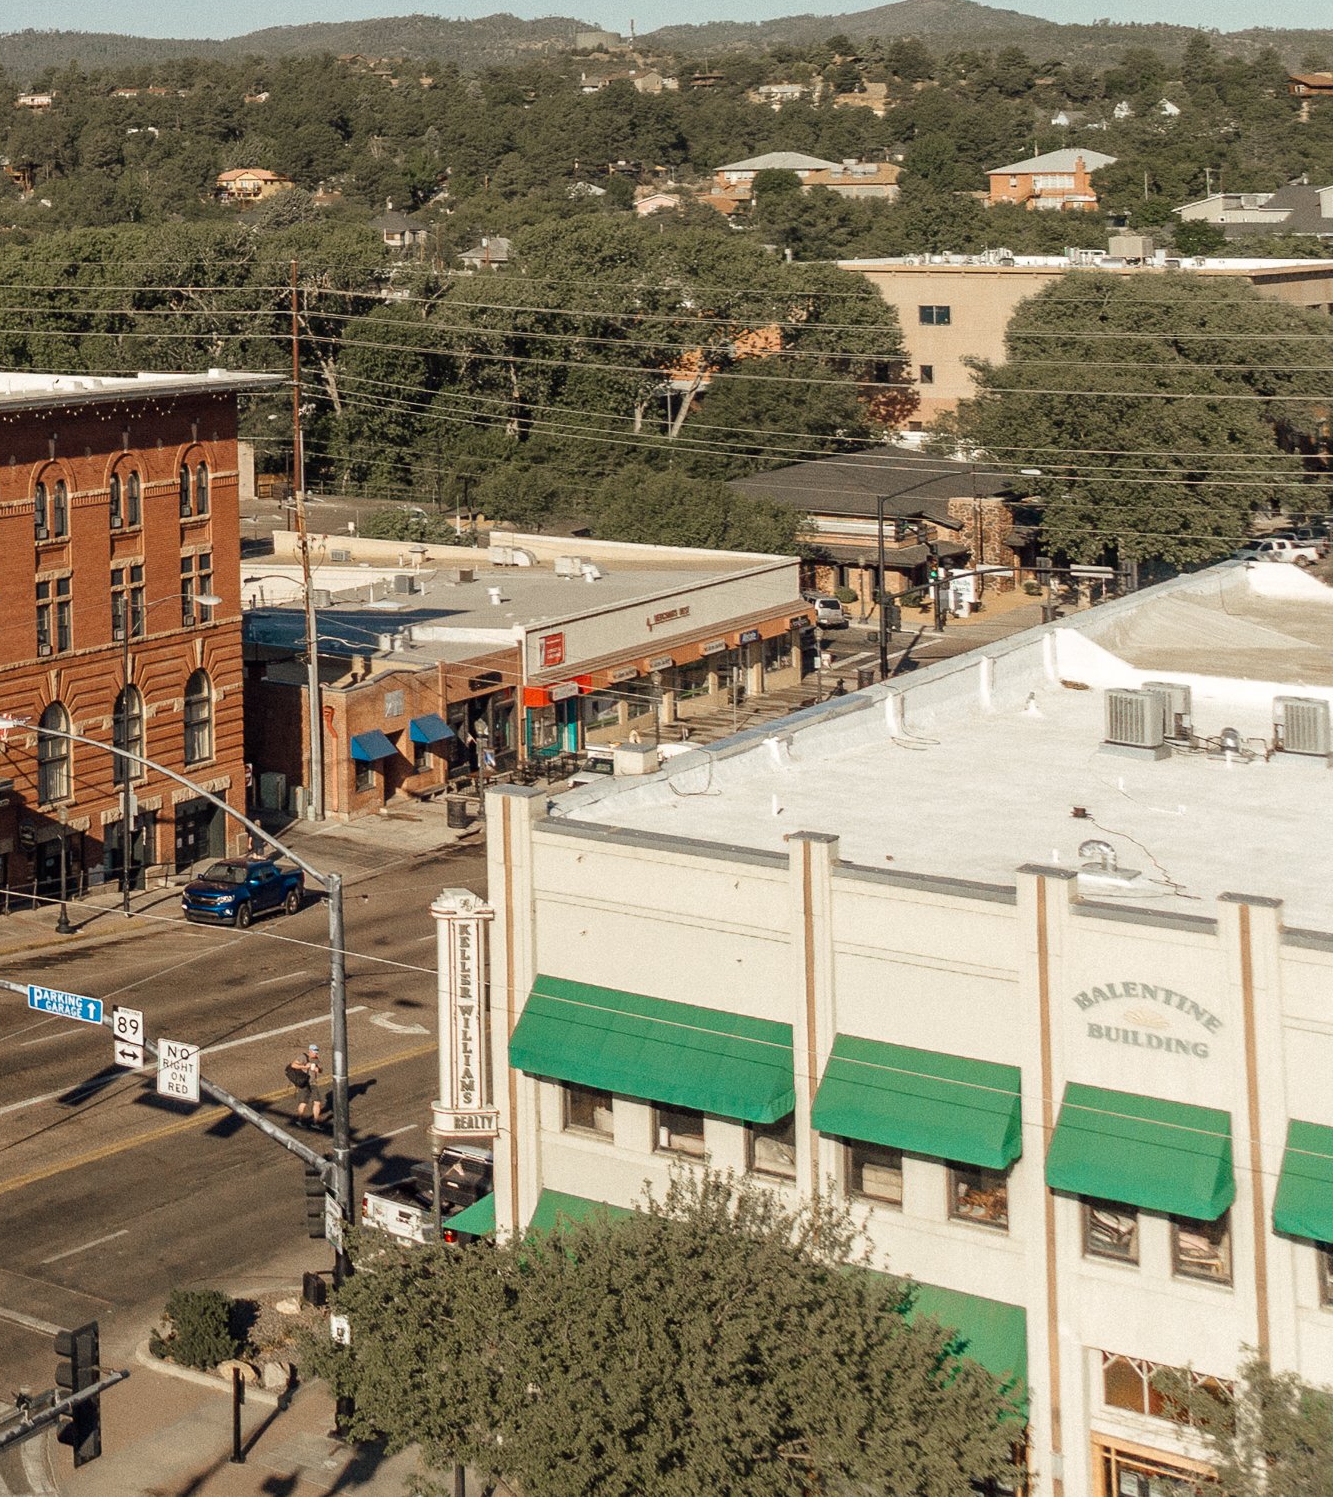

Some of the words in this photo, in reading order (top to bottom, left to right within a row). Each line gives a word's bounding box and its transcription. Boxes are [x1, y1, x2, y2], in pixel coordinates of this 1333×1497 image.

[458, 924, 472, 999] KELLER
[33, 987, 83, 1008] PARKING
[45, 1000, 83, 1019] GARAGE
[1072, 981, 1224, 1035] BALENTINE
[118, 1016, 139, 1036] 89
[1087, 1022, 1210, 1059] BUILDING
[167, 1045, 190, 1061] NO
[458, 1005, 475, 1104] WILLIAMS
[162, 1058, 194, 1074] RIGHT
[171, 1071, 186, 1083] ON
[167, 1082, 188, 1095] RED
[454, 1114, 493, 1130] REALTY
